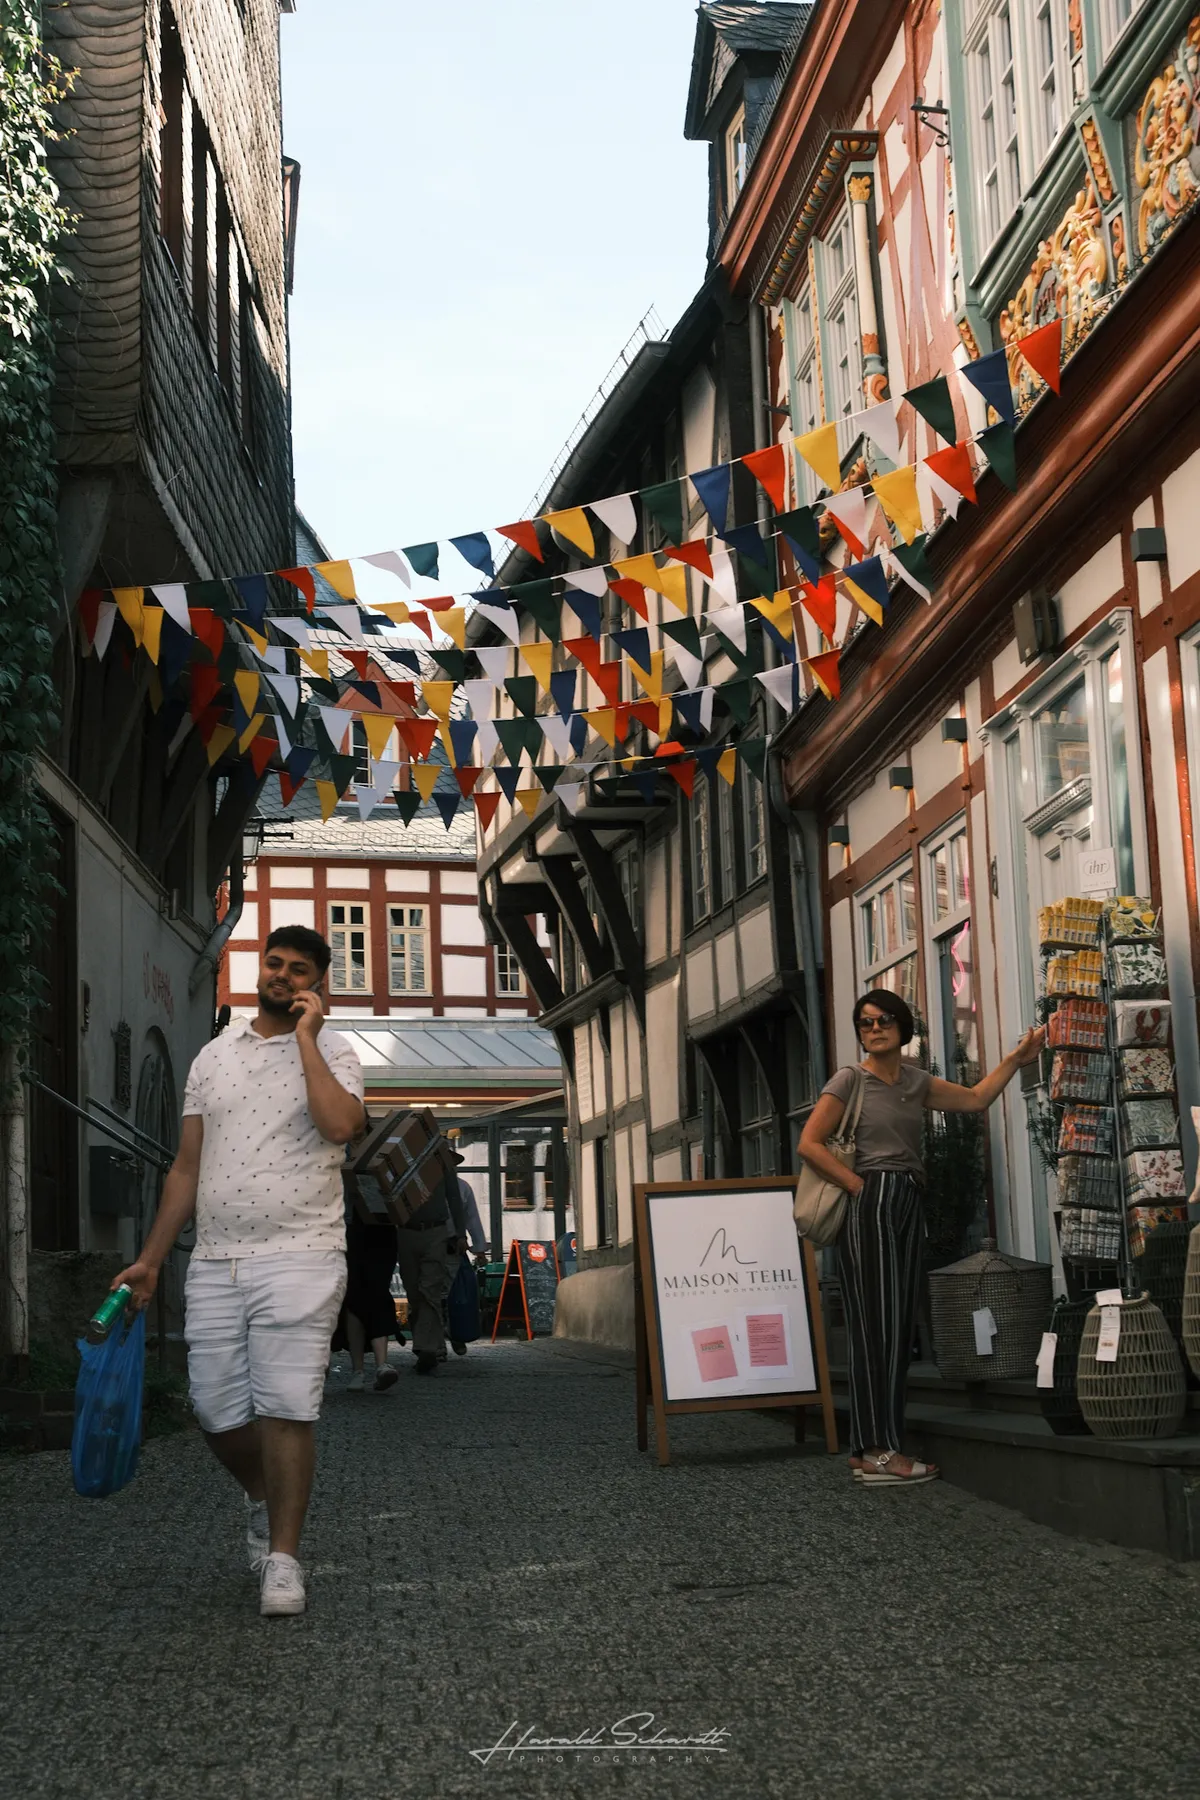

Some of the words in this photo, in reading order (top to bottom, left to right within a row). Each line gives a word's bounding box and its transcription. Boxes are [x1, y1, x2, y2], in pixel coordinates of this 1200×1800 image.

[1089, 860, 1107, 875] ihr
[664, 1271, 740, 1290] MAISON
[745, 1268, 798, 1284] TEHL
